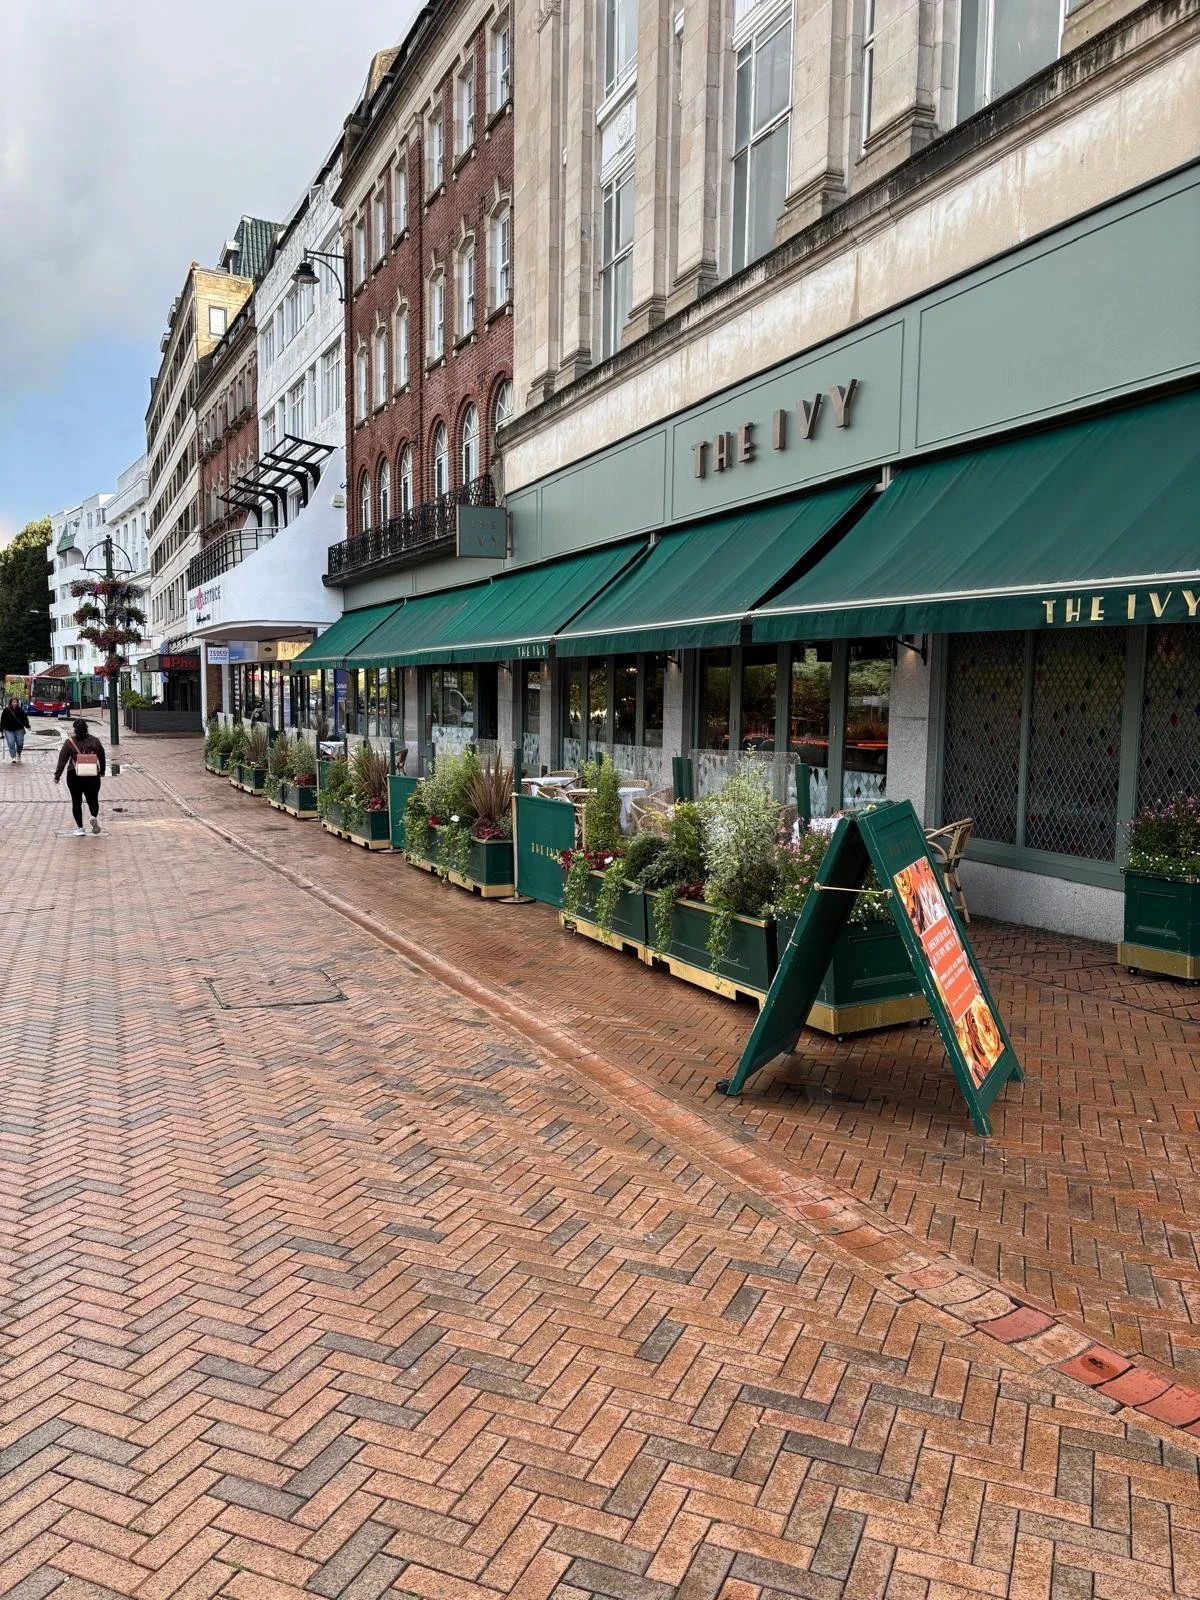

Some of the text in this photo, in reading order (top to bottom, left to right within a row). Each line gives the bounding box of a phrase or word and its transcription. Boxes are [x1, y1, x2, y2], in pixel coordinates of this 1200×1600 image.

[692, 378, 860, 479] THE IVY
[1042, 589, 1200, 624] THE IVY
[517, 644, 547, 658] THE IVY
[172, 655, 196, 669] Pho
[531, 842, 544, 856] THE
